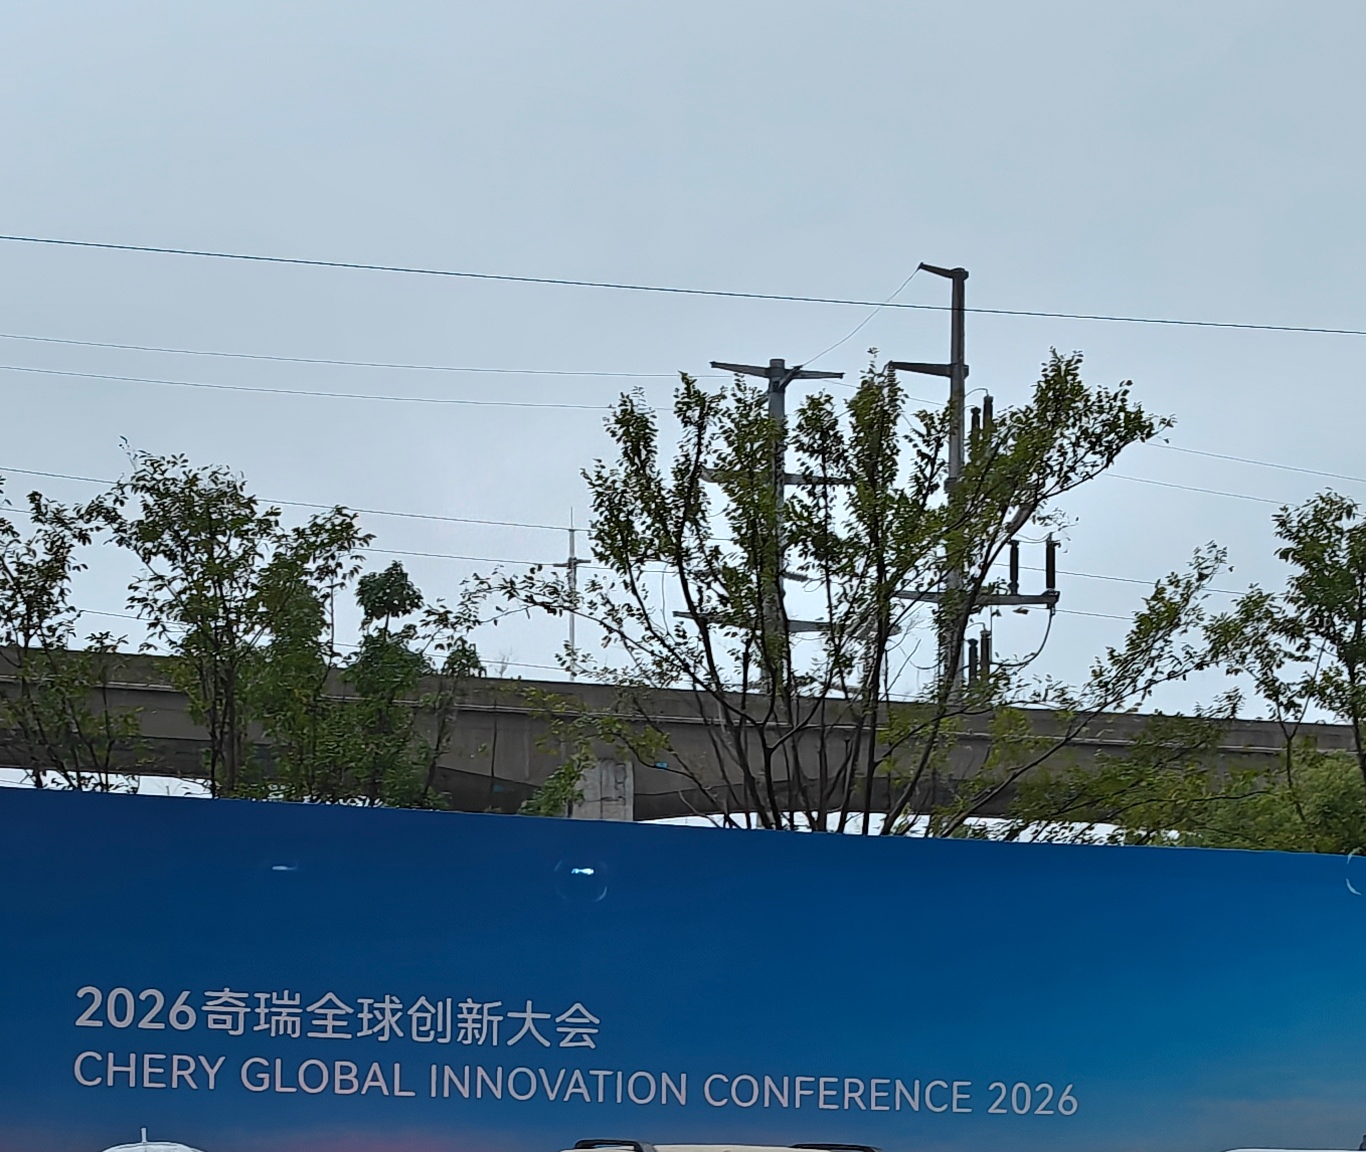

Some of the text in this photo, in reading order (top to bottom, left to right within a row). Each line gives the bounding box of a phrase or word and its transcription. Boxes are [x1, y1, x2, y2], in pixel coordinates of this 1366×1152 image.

[74, 985, 601, 1050] 2026奇瑞全球创新大会
[73, 1051, 1079, 1117] CHERY GLOBAL INNOVATION CONFERENCE 2026
